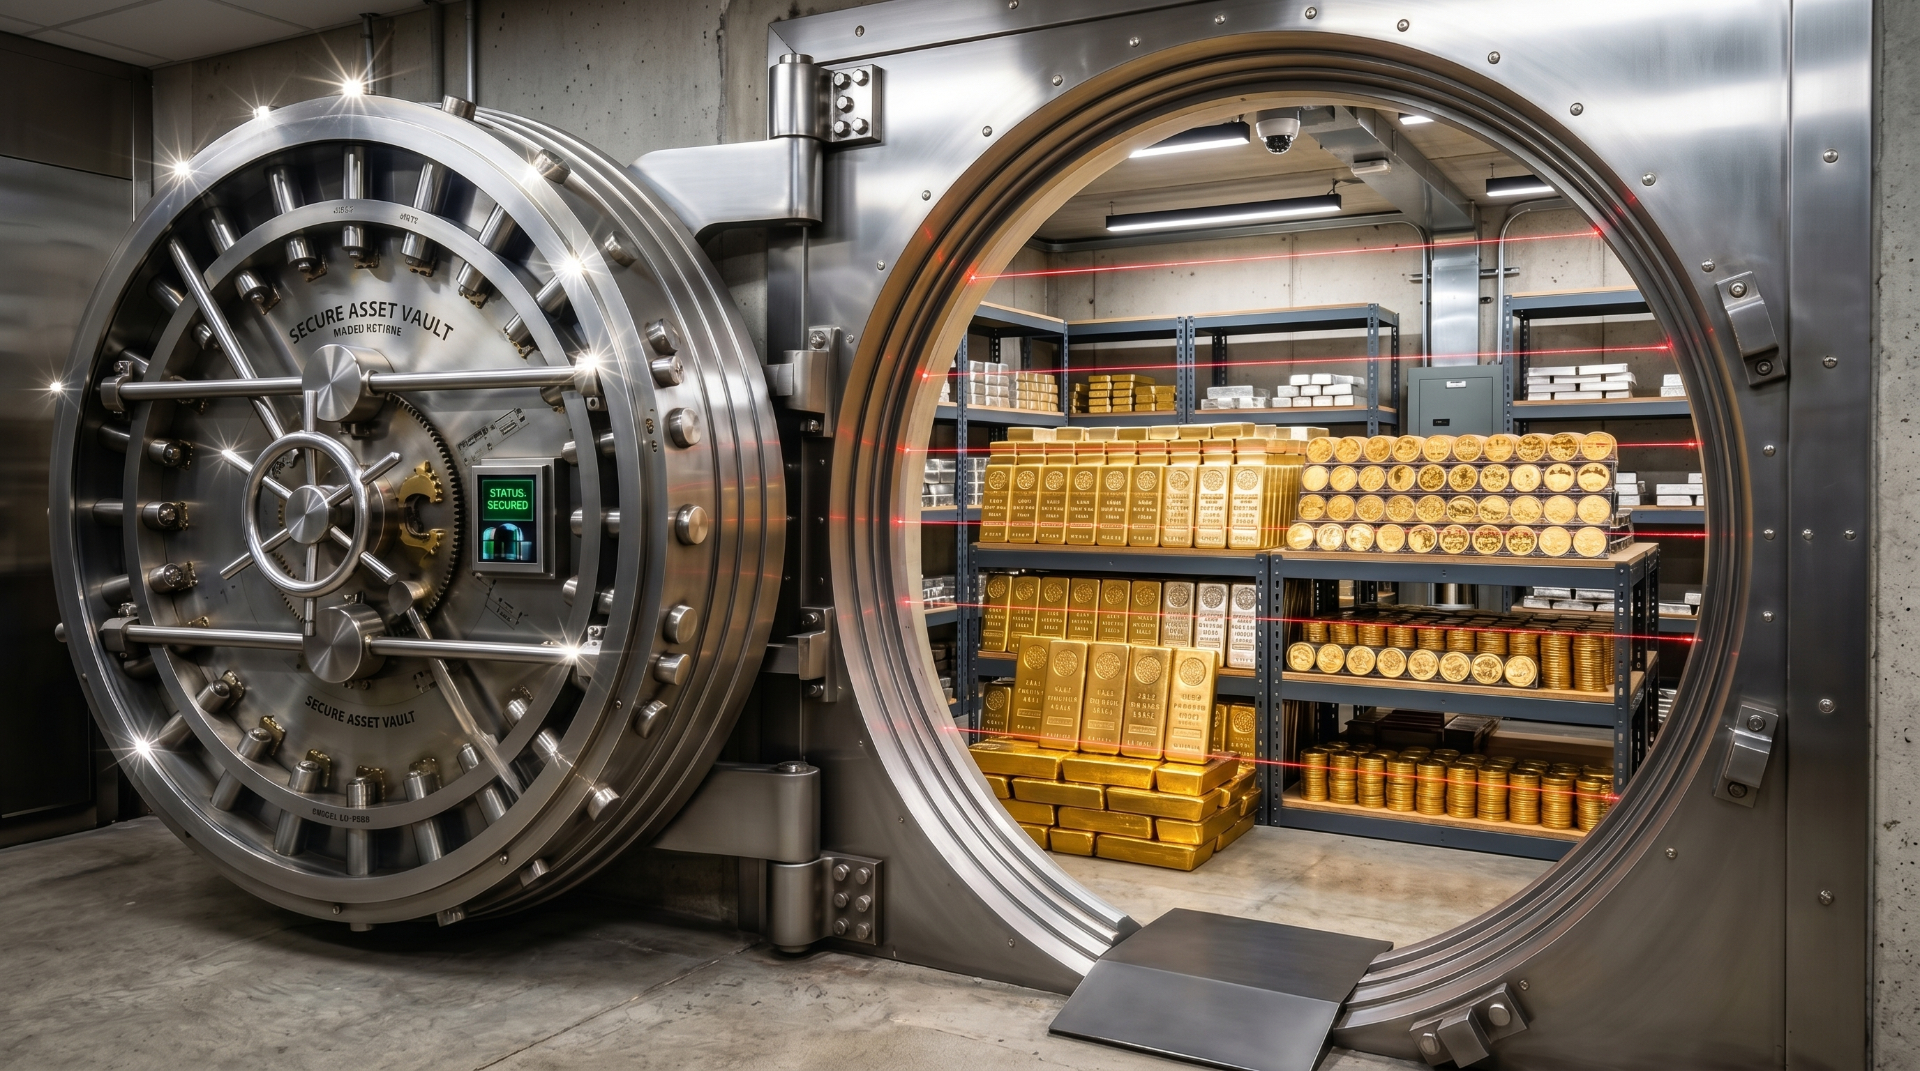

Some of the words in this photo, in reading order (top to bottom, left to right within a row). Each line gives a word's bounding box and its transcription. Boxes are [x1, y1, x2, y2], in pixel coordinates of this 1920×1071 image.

[289, 305, 345, 344] SECURE
[349, 301, 398, 319] ASSET
[402, 304, 454, 341] VAULT
[487, 500, 529, 510] SECURED
[305, 695, 345, 722] SECURE
[347, 713, 380, 729] ASSET
[382, 710, 415, 728] VAULT
